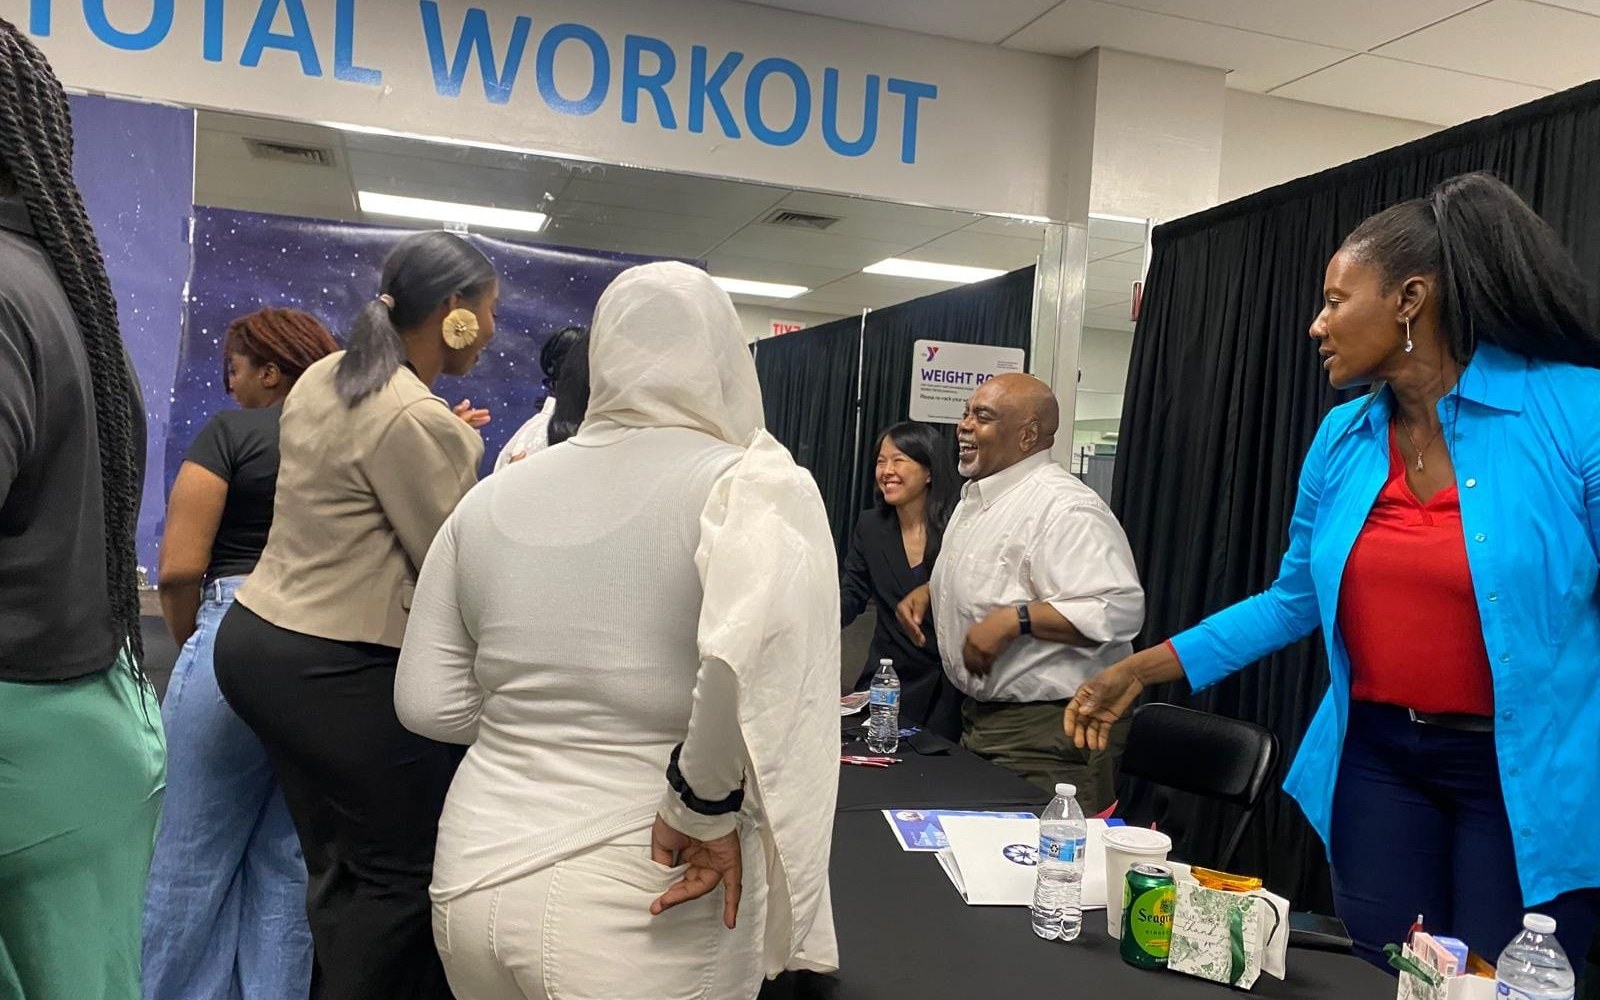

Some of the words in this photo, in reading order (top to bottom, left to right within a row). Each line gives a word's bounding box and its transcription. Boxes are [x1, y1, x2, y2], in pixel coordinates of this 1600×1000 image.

[419, 0, 937, 165] WORKOUT
[921, 368, 973, 384] WEIGHT
[1138, 908, 1173, 925] Seagr
